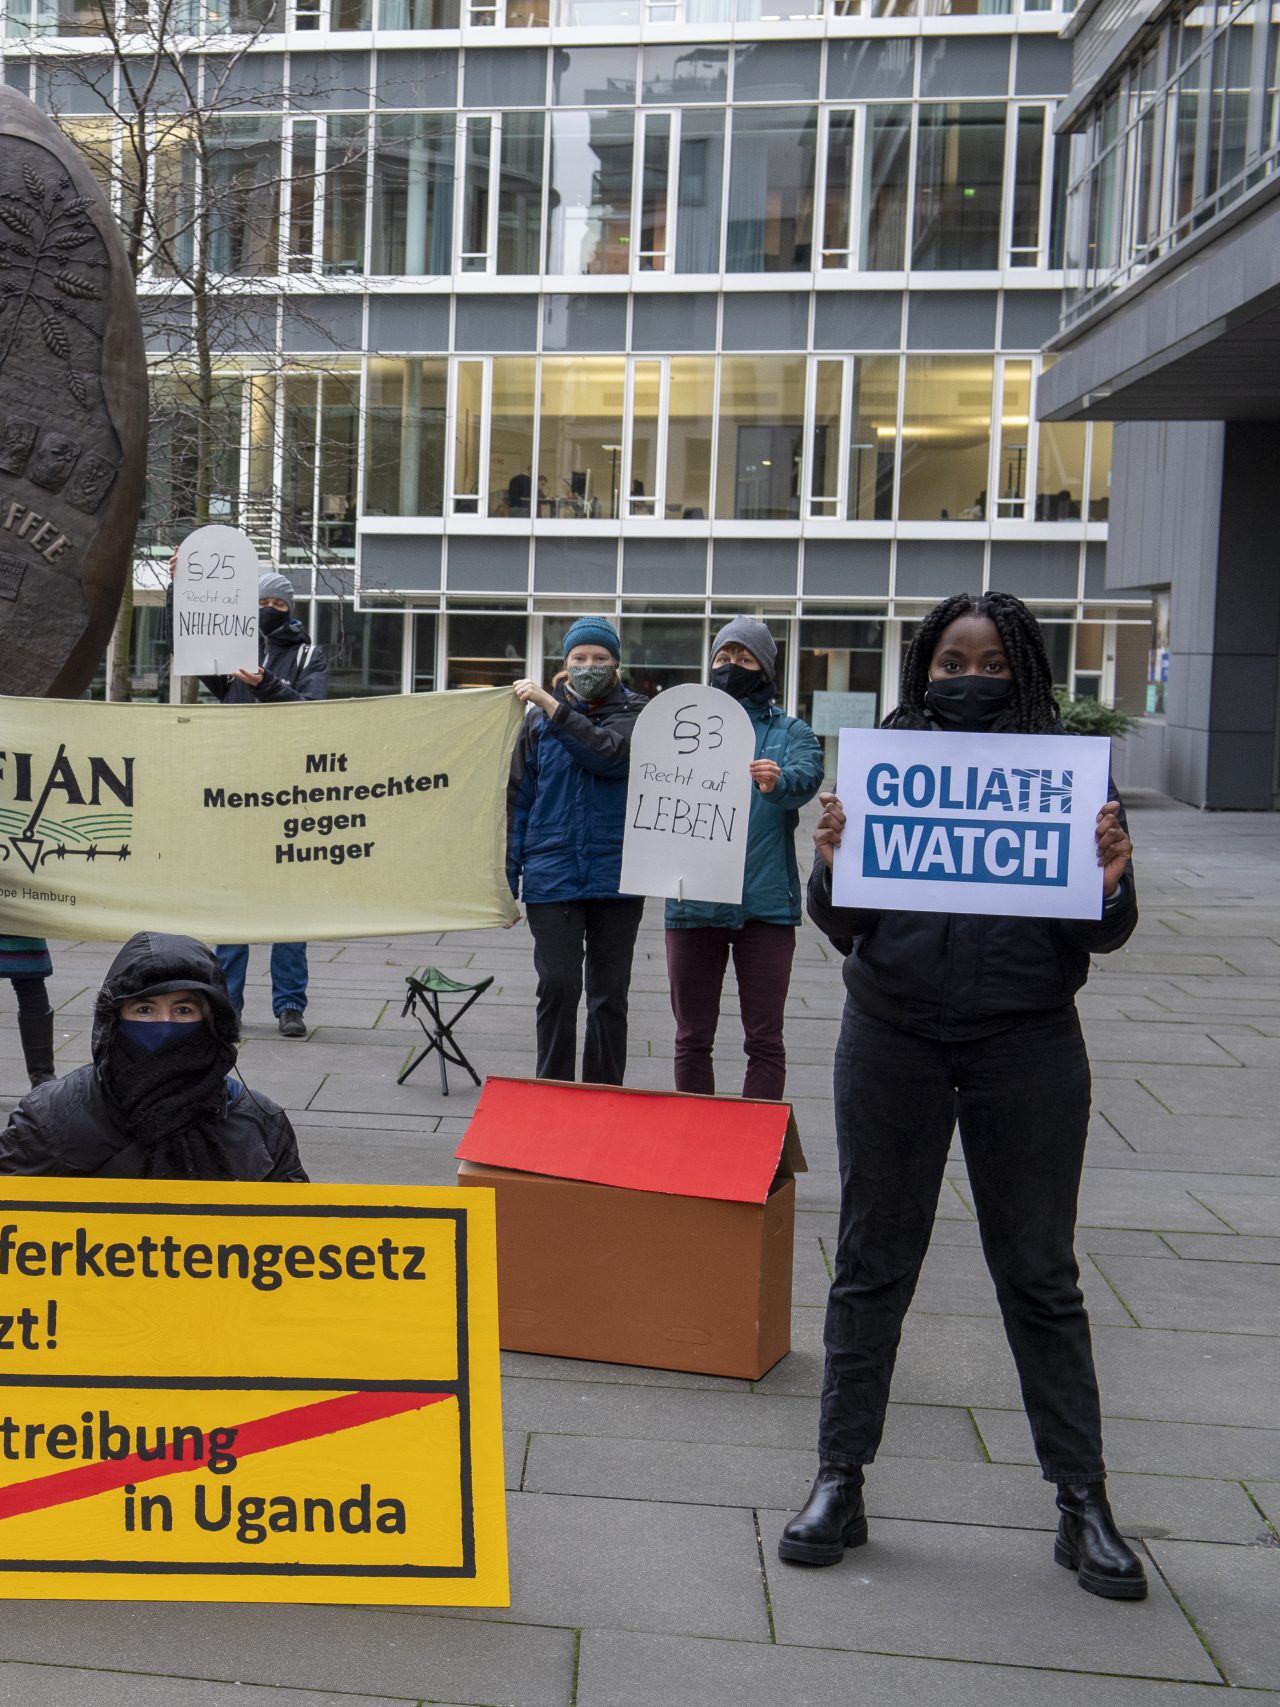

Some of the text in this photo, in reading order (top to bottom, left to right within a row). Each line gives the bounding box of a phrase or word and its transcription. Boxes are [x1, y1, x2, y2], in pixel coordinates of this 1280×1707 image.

[183, 589, 241, 605] Recht auf
[179, 611, 256, 638] NAHRUNG
[305, 753, 348, 774] Mit
[639, 762, 730, 792] Recht auf
[203, 773, 449, 808] Menschenrechten
[866, 763, 1074, 814] GOLIATH
[283, 813, 366, 839] gegen
[633, 794, 736, 842] LEBEN
[275, 842, 375, 865] Hunger
[872, 823, 1060, 879] WATCH
[22, 887, 76, 905] Hamburg
[123, 1484, 407, 1545] in Uganda
